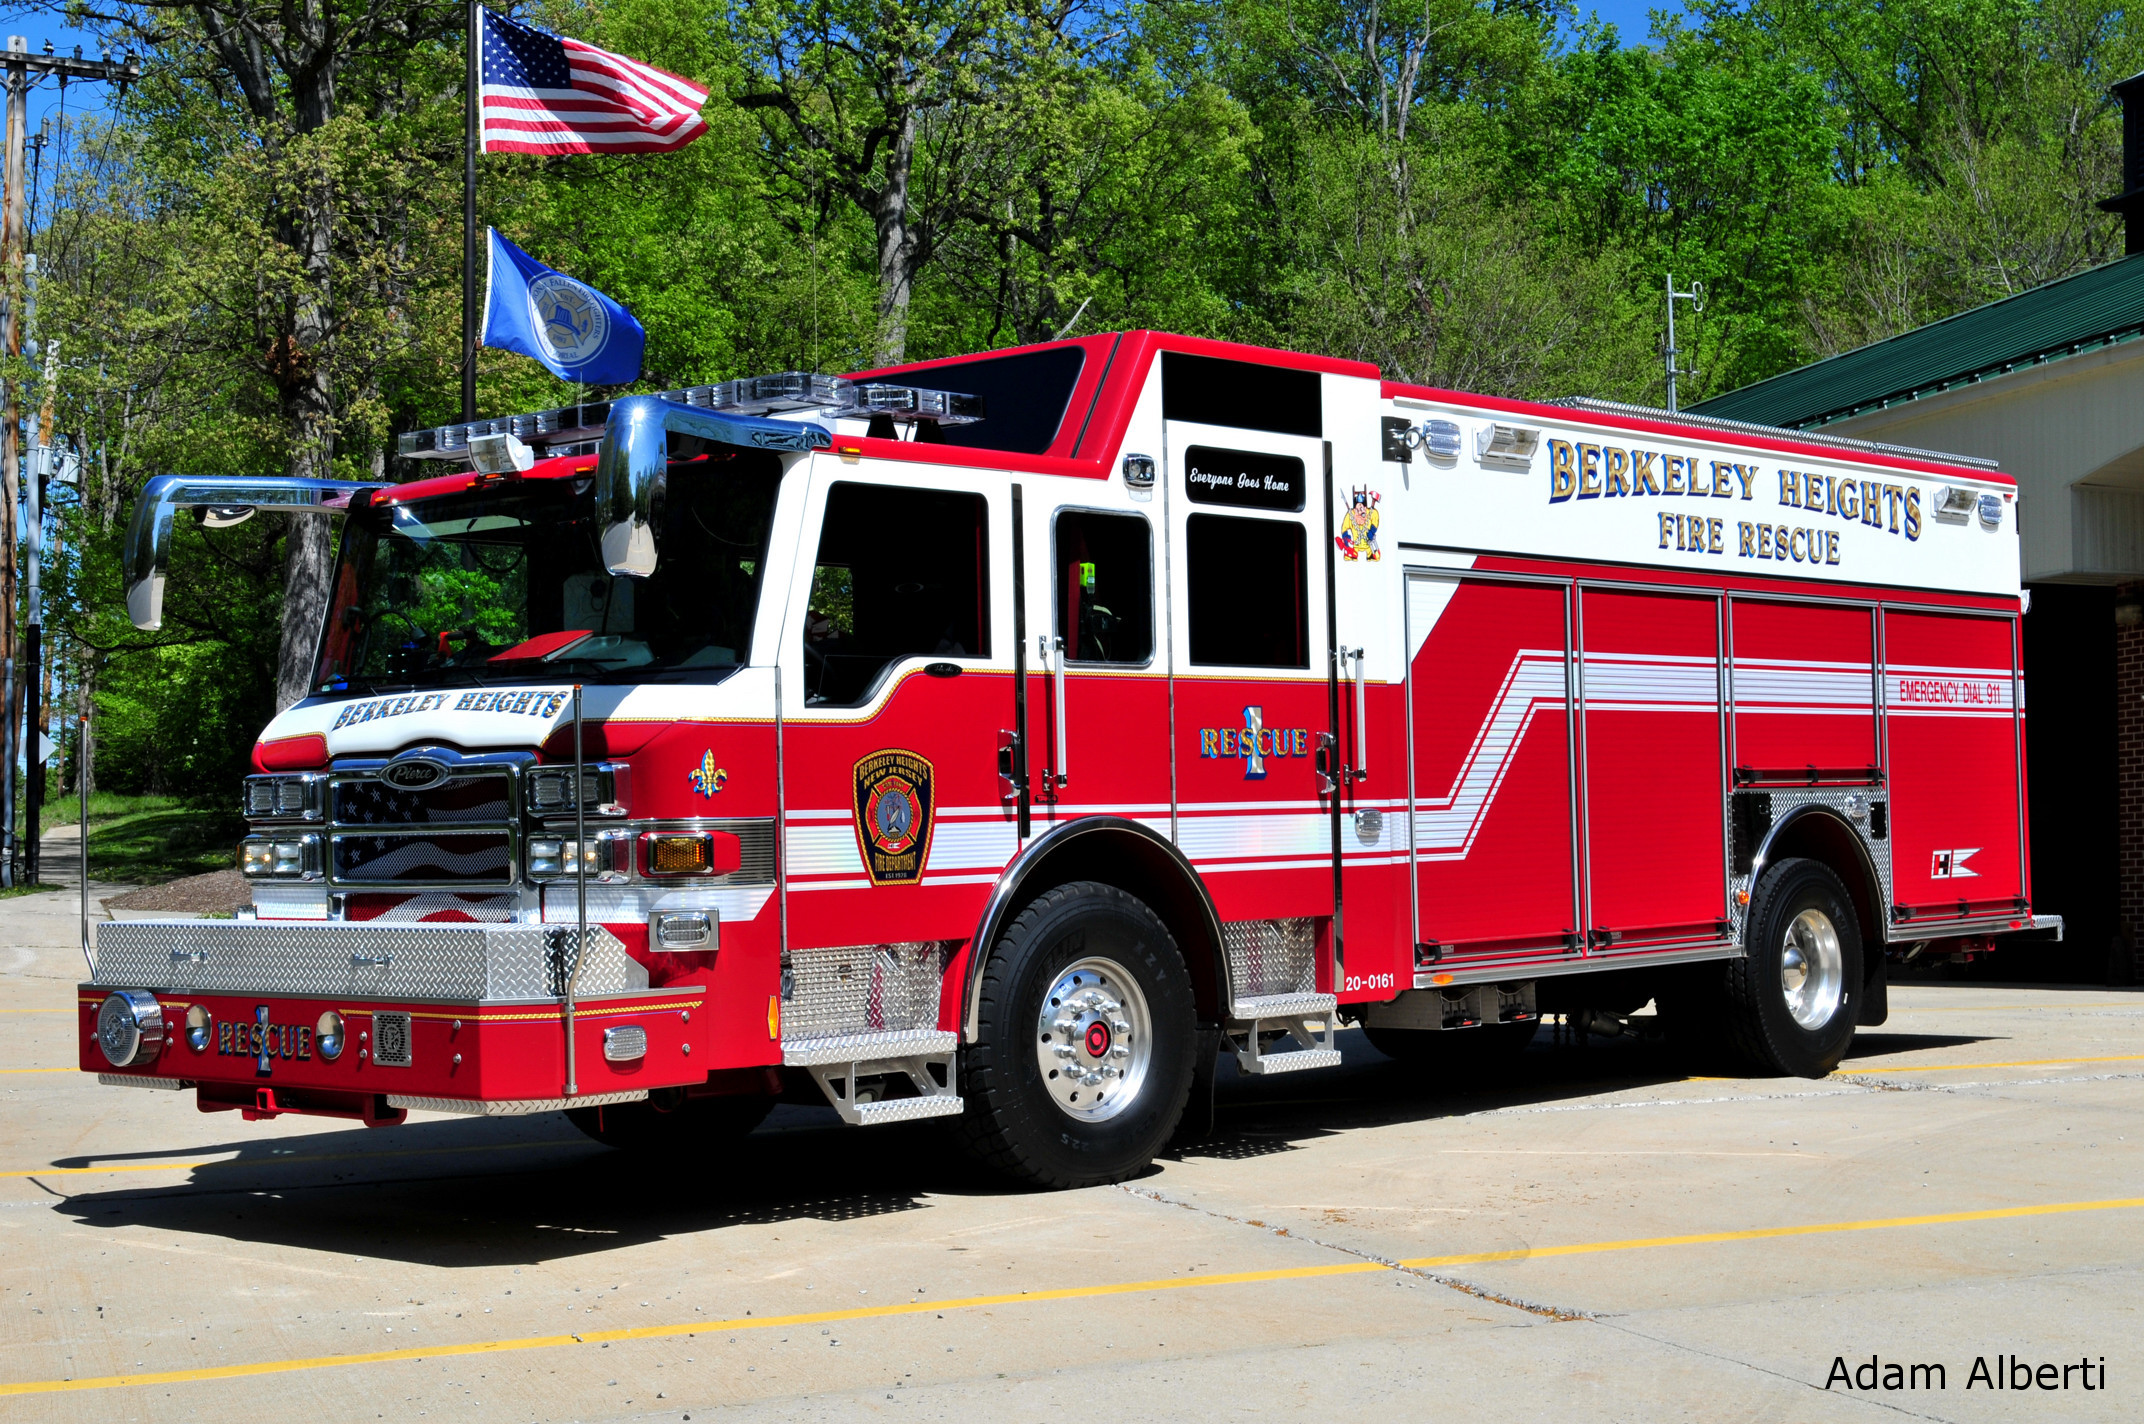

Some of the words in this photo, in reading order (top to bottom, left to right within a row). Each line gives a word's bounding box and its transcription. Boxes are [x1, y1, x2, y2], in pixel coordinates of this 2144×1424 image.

[549, 278, 579, 292] FALLEN
[1189, 467, 1233, 490] Everyone
[1237, 472, 1260, 489] Goes
[1264, 474, 1289, 491] Home
[1547, 438, 1760, 504] BERKELEY
[1777, 469, 1922, 542] HEIGHTS
[1657, 512, 1725, 554] FIRE
[1737, 521, 1841, 566] RESCUE
[1900, 680, 1959, 703] EMERGENCY
[1963, 682, 1984, 704] DIAL
[1986, 683, 2000, 704] 911
[332, 693, 451, 732] BERKELEY
[454, 691, 570, 719] HEIGHTS
[1200, 728, 1308, 759] RESCUE
[393, 765, 432, 782] Pierce
[859, 755, 895, 781] BERKELEY
[896, 755, 928, 780] HEIGHTS
[863, 767, 887, 790] NEW
[888, 766, 923, 787] JERSEY
[1346, 972, 1394, 992] 20-0161
[218, 1020, 312, 1061] RESCUE
